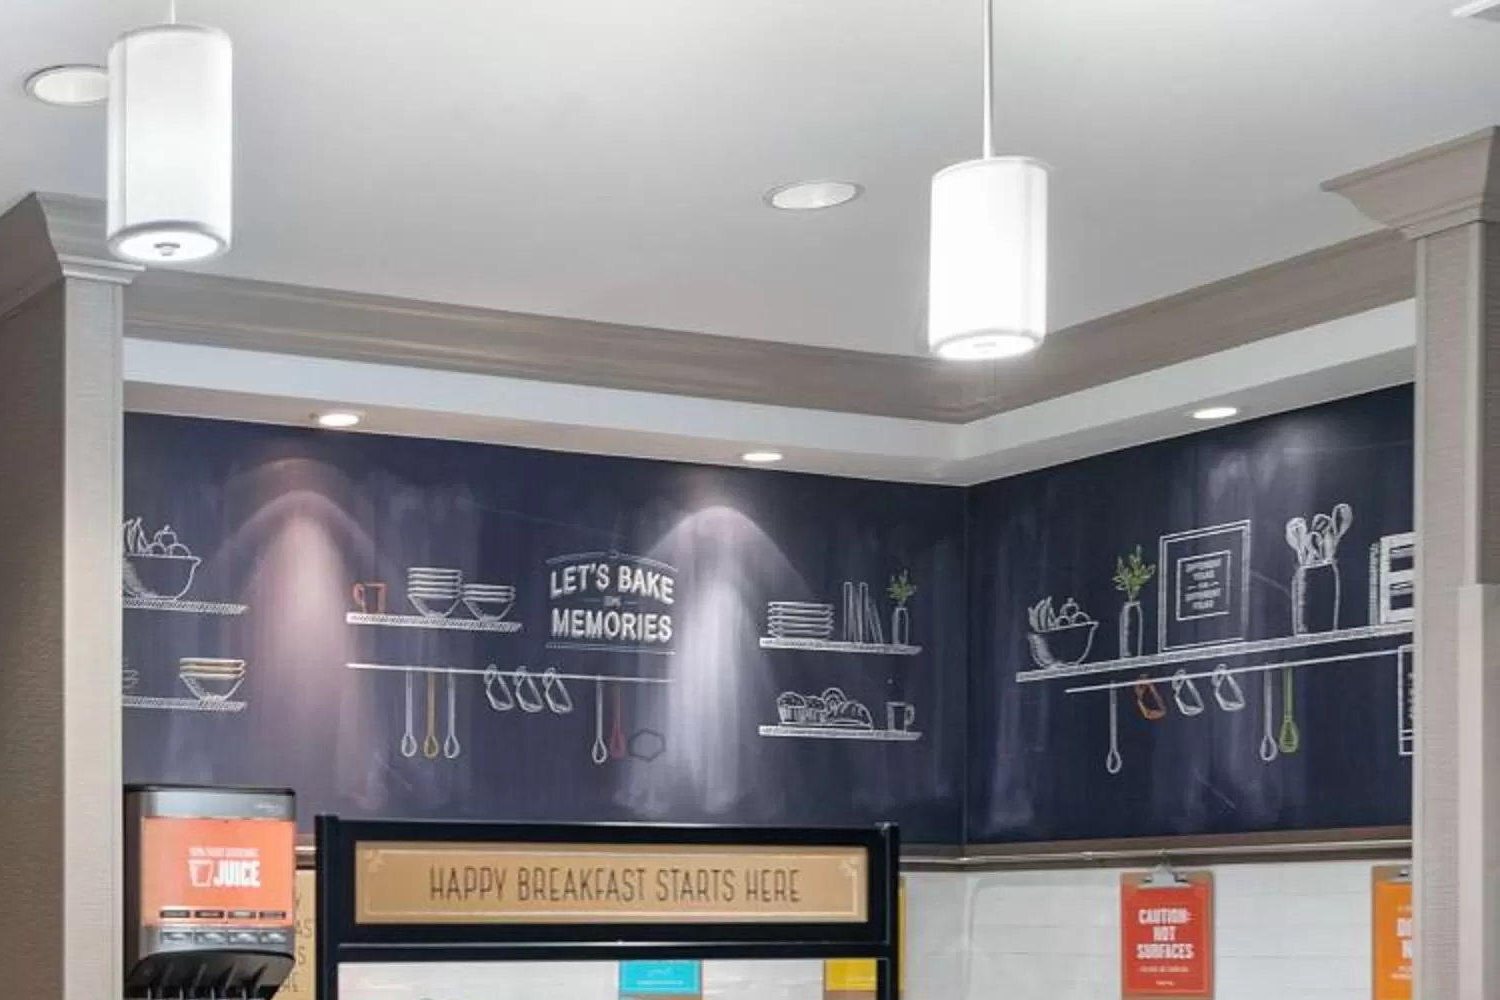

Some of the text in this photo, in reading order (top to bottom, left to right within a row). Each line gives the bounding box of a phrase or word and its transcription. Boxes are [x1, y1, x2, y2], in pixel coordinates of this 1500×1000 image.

[550, 563, 676, 605] LET'S BAKE
[550, 607, 673, 642] MEMORIES
[213, 860, 261, 889] JUICE
[429, 865, 802, 904] HAPPY BREAKFAST STARTS HERE
